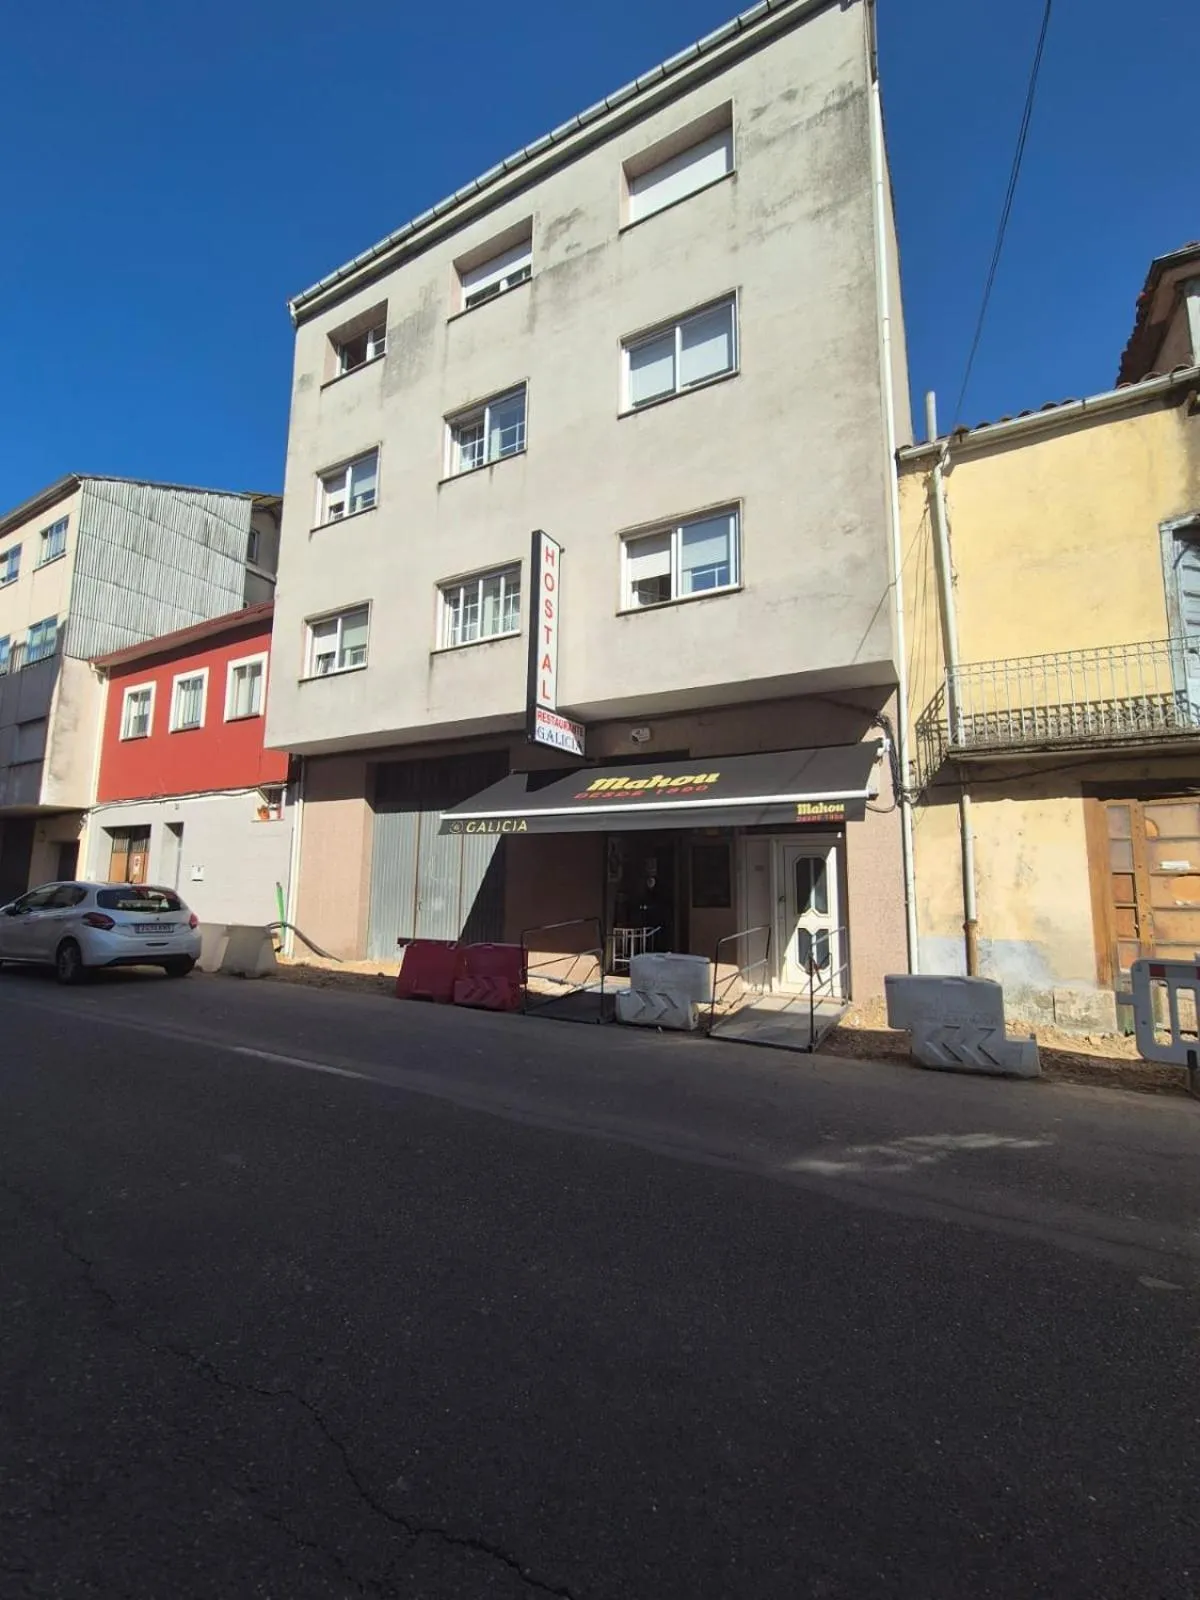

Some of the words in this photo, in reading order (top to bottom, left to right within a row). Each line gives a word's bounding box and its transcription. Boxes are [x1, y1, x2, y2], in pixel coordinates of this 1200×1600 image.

[542, 546, 555, 700] HOSTAL
[537, 710, 584, 736] RESTAURANTE
[537, 726, 584, 753] GALICIA
[586, 772, 720, 791] Mahou
[574, 789, 646, 799] DESDE
[797, 802, 845, 815] Mahou
[466, 819, 528, 833] GALICIA
